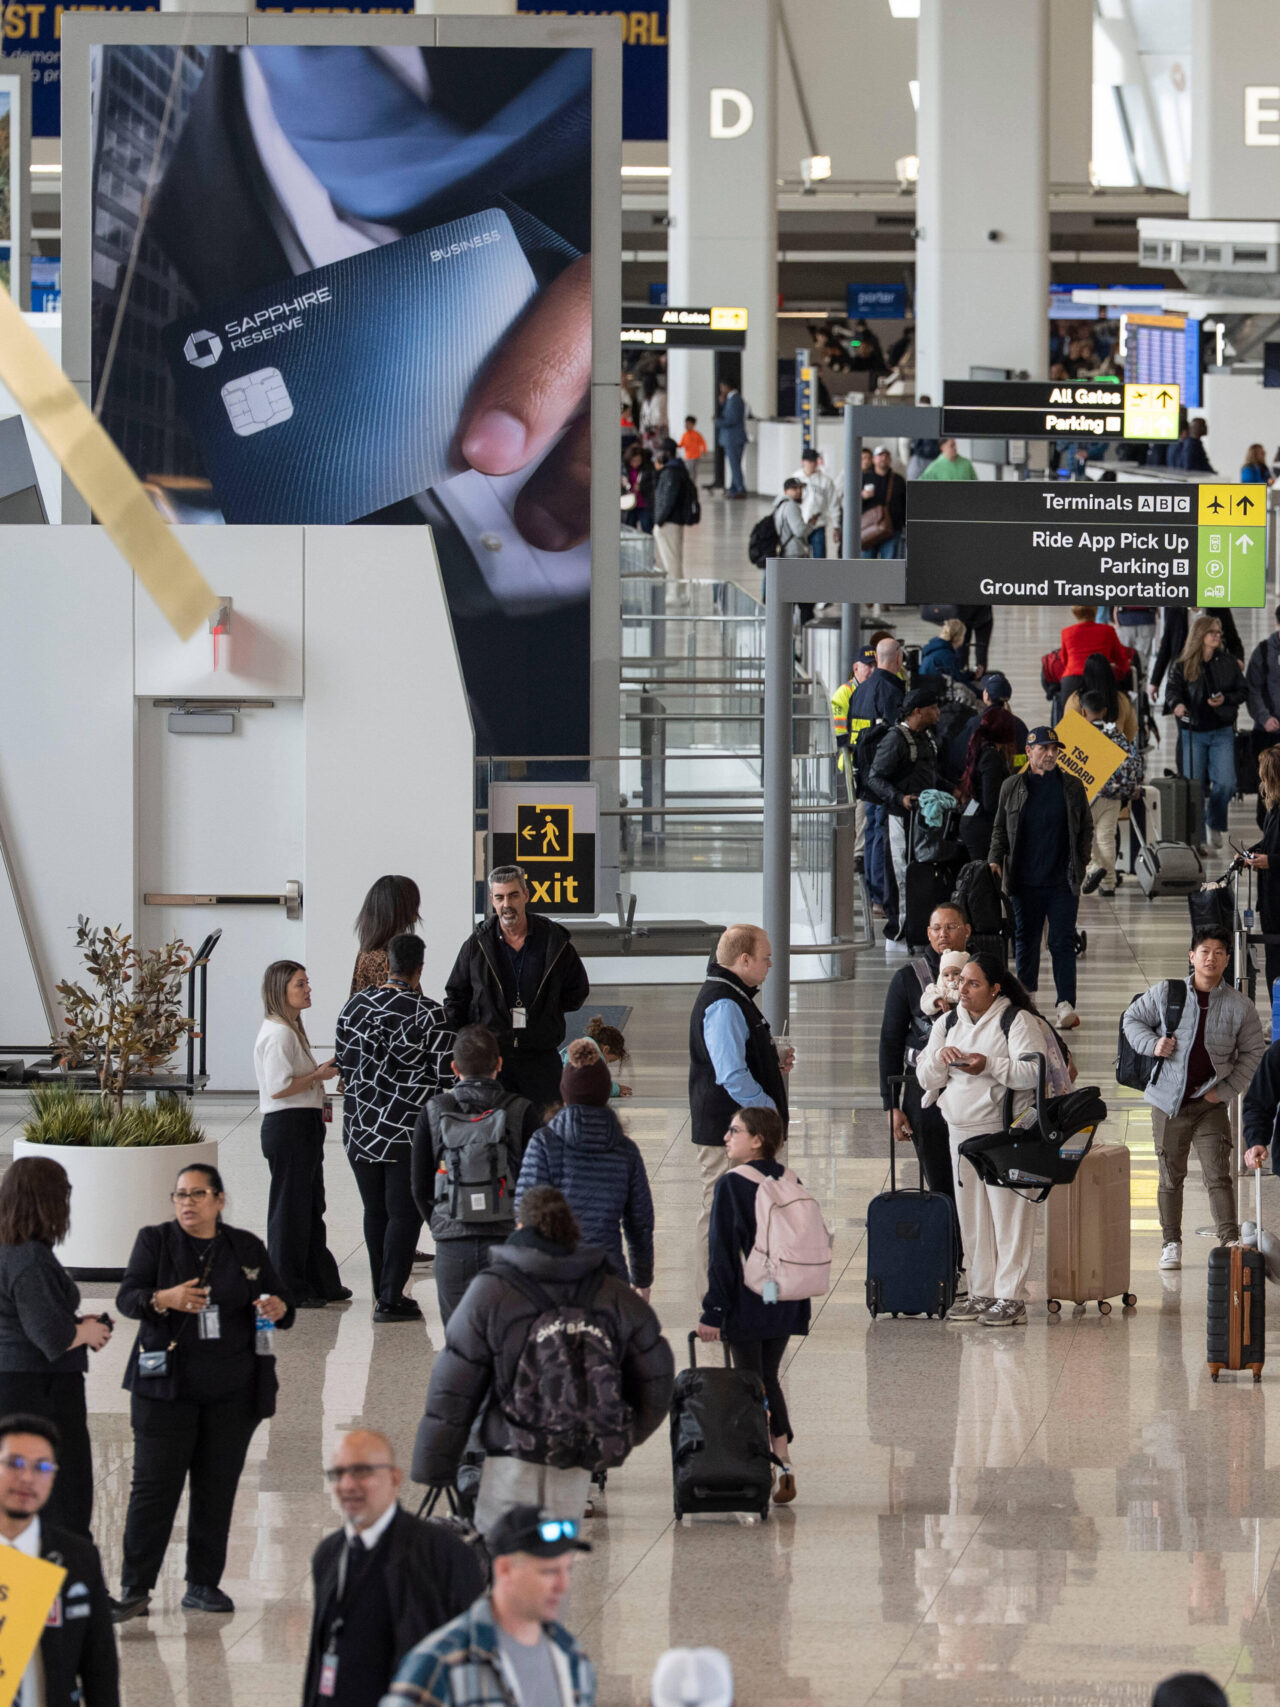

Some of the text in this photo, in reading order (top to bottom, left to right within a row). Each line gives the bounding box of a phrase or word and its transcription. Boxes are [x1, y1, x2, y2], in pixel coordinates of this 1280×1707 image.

[709, 88, 754, 139] D
[429, 229, 502, 262] BUSINESS
[224, 286, 333, 338] SAPPHIRE
[662, 311, 679, 324] All
[229, 315, 305, 352] RESERVE
[1049, 388, 1122, 405] All Gates
[1045, 415, 1105, 435] Parking
[1042, 493, 1134, 511] Terminals
[1032, 531, 1190, 553] Ride App Pick Up
[1100, 558, 1170, 579] Parking
[979, 579, 1190, 602] Ground Transportation
[1070, 745, 1090, 766] TSA
[1057, 749, 1096, 785] TANDARD
[524, 871, 580, 904] xit
